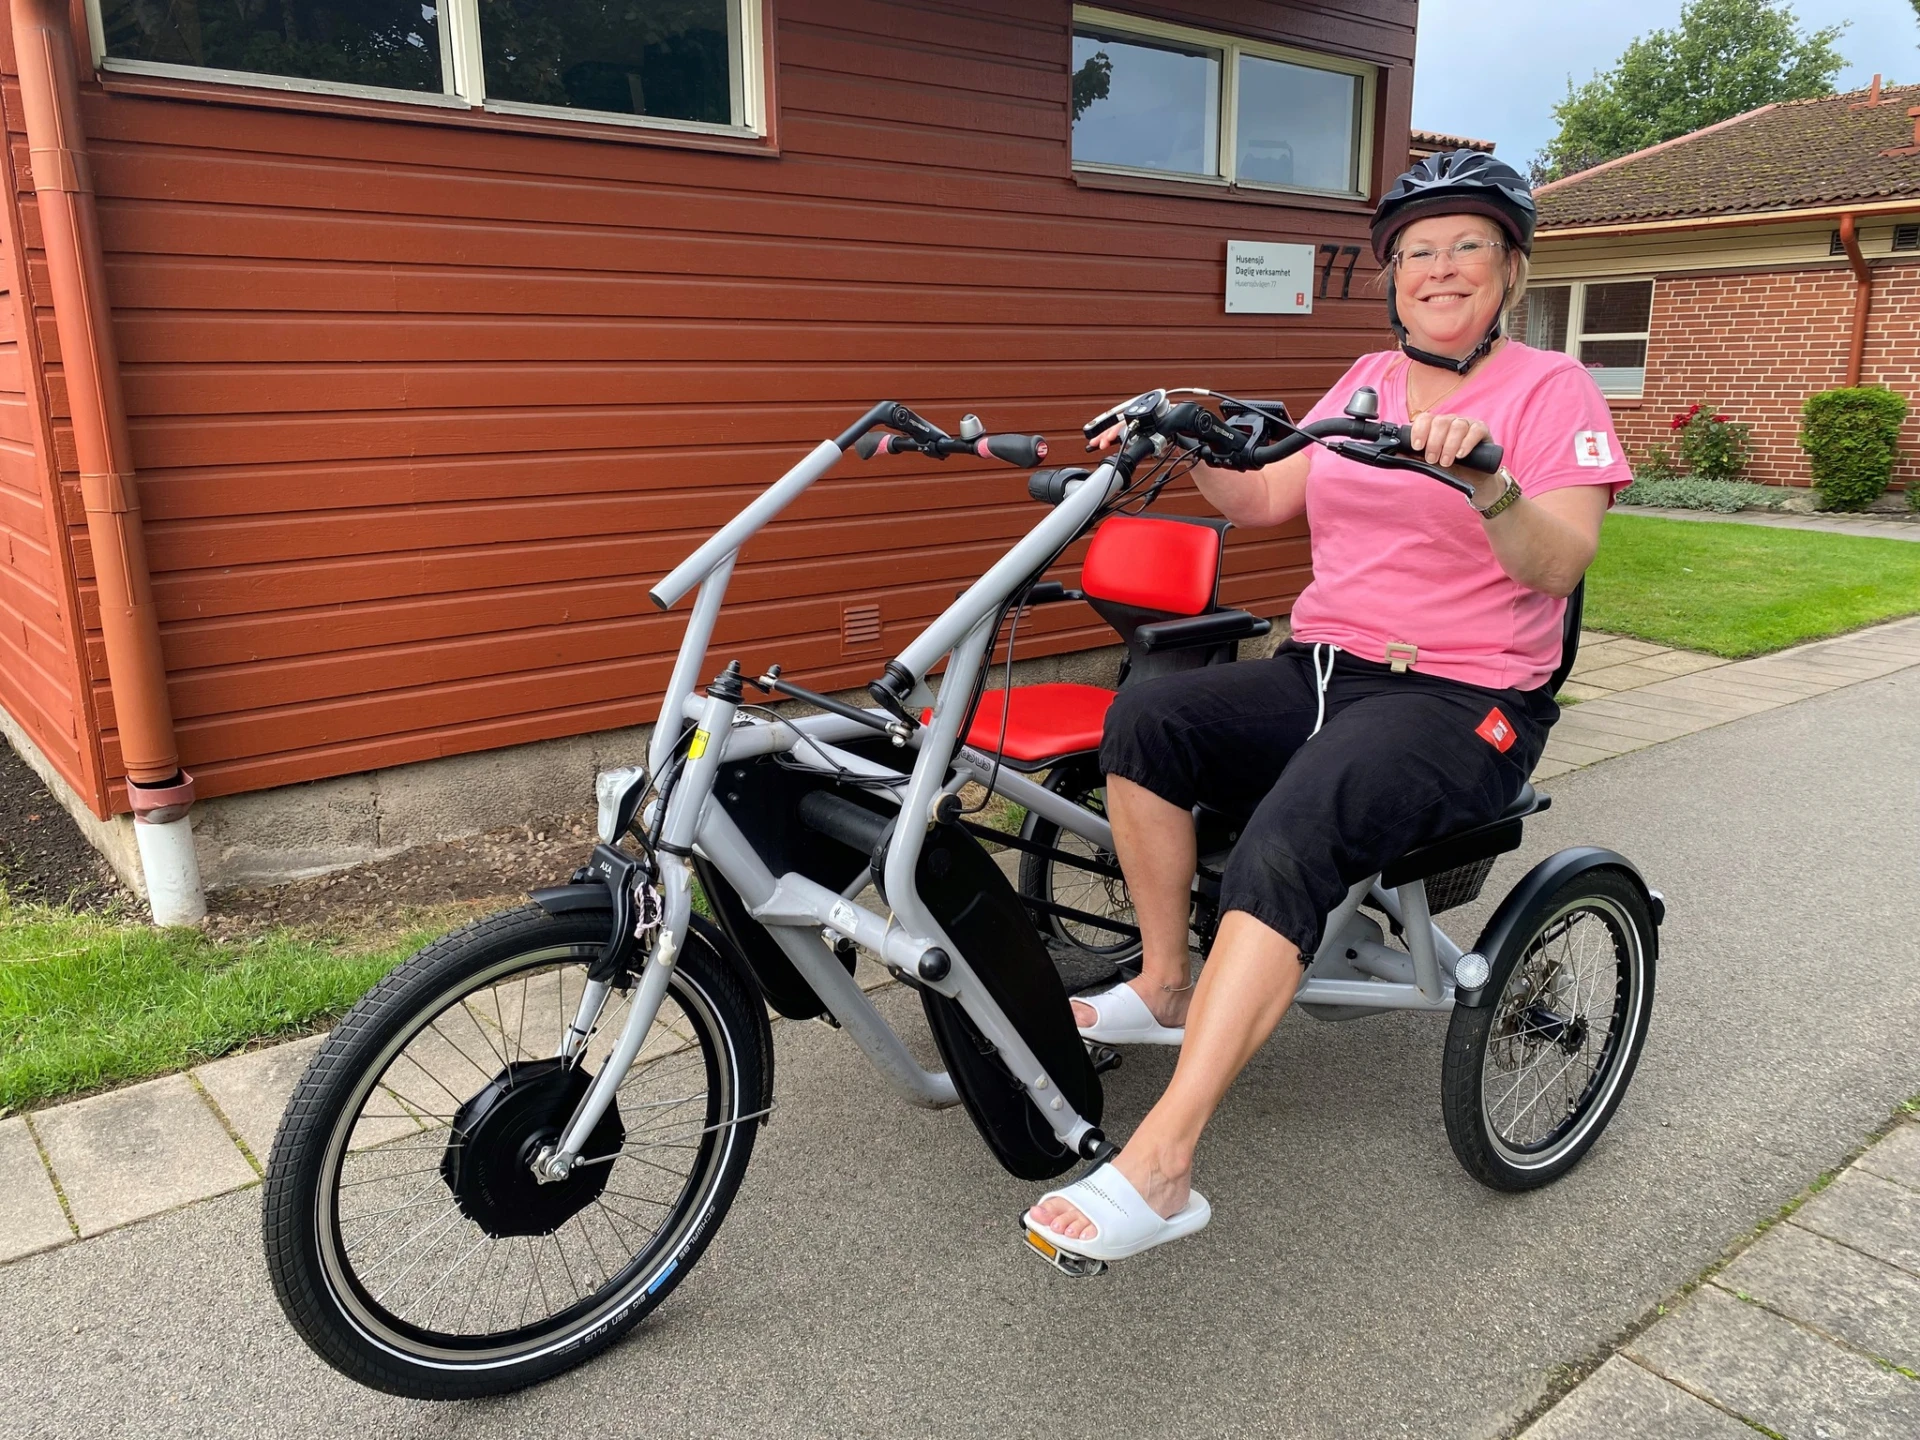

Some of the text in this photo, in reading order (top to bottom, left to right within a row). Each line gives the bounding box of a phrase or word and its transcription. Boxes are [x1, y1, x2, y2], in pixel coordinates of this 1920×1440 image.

[1235, 255, 1265, 266] Husensjö
[1235, 266, 1291, 277] Daglig verksamhet
[1319, 244, 1361, 300] 77
[1270, 280, 1277, 288] 77
[600, 861, 612, 875] AXA
[678, 1204, 716, 1260] SCHWALBE
[584, 1293, 647, 1344] BIG BEN PLUS
